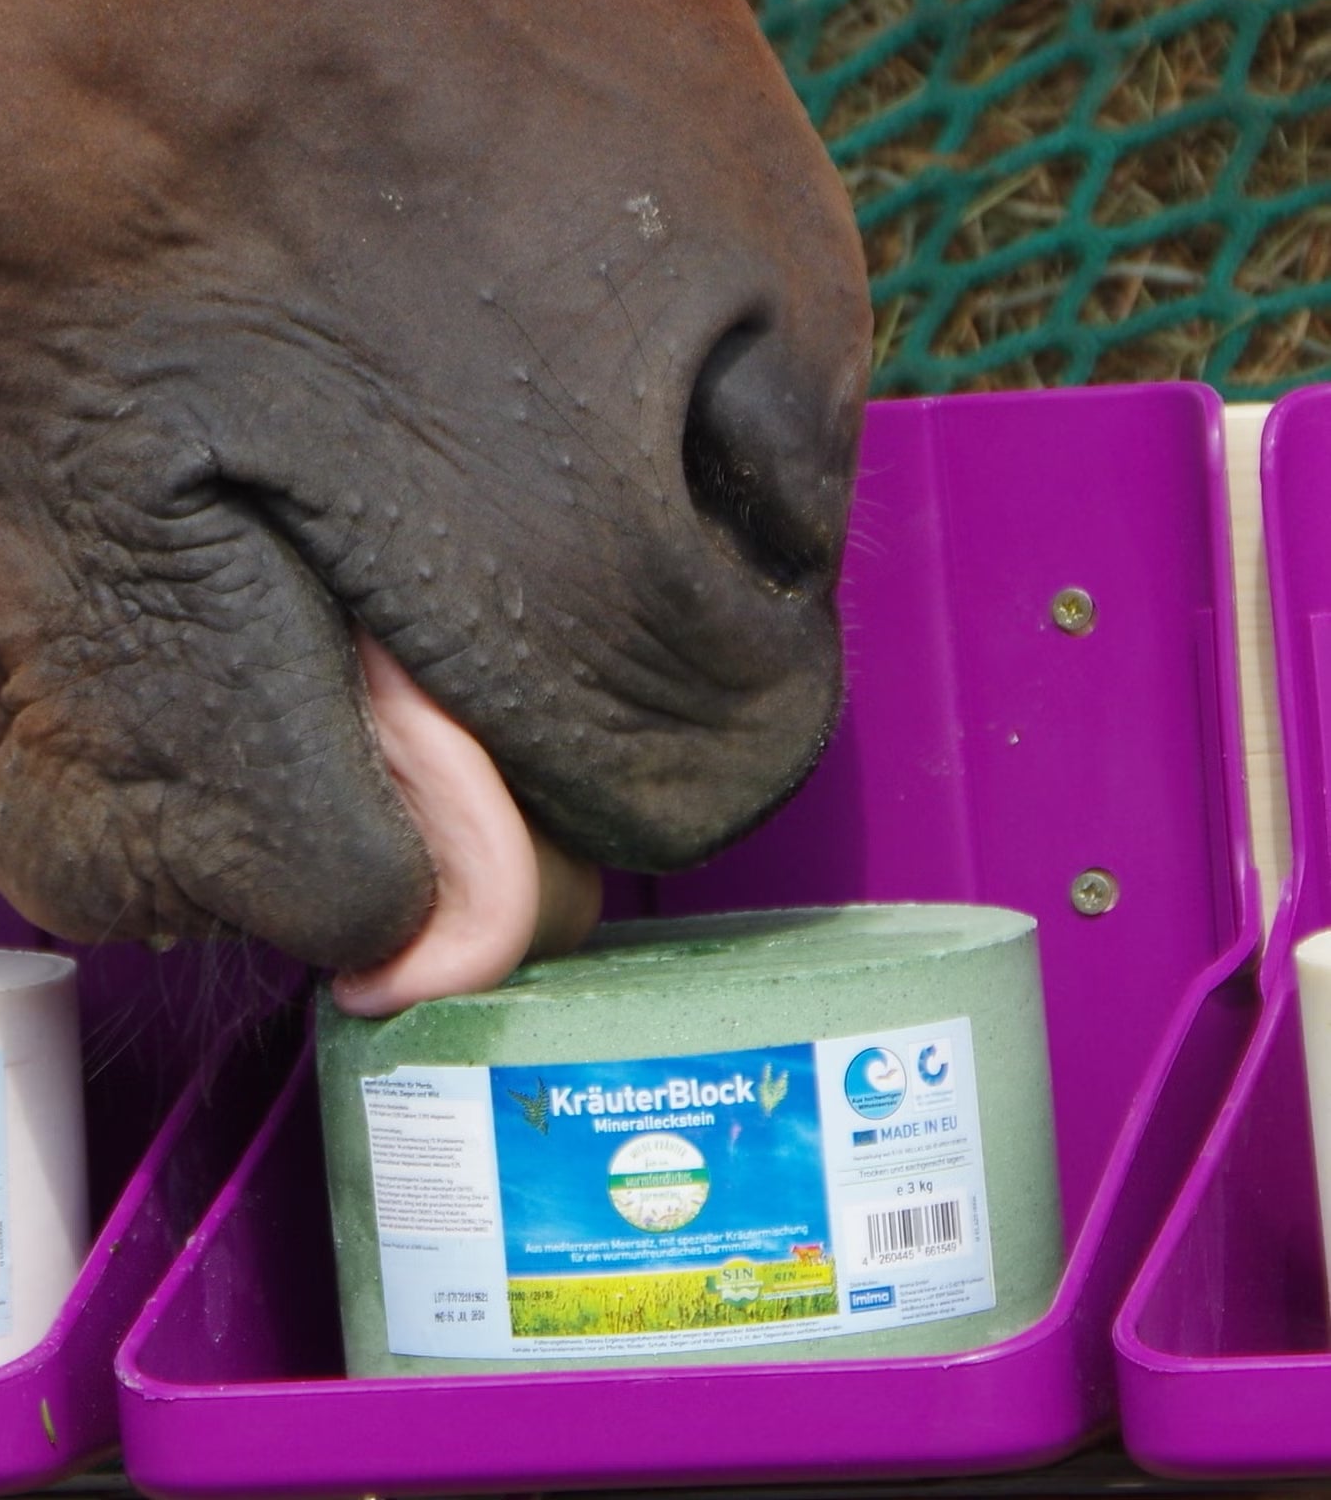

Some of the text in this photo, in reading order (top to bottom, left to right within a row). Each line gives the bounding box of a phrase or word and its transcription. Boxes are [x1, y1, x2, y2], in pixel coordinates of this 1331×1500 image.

[550, 1074, 757, 1117] KräuterBlock
[594, 1111, 715, 1134] Mineralleckstein
[880, 1115, 958, 1142] MADE IN EU
[890, 1164, 904, 1175] und
[907, 1181, 915, 1195] 3
[919, 1180, 933, 1195] kg
[524, 1242, 543, 1254] Aus
[658, 1235, 677, 1248] mit
[677, 1232, 724, 1248] spezieller
[725, 1225, 808, 1242] Kräutermischung
[570, 1252, 585, 1263] für
[586, 1251, 601, 1262] ein
[862, 1256, 869, 1266] 4
[722, 1267, 753, 1281] SIN
[851, 1290, 891, 1307] imima
